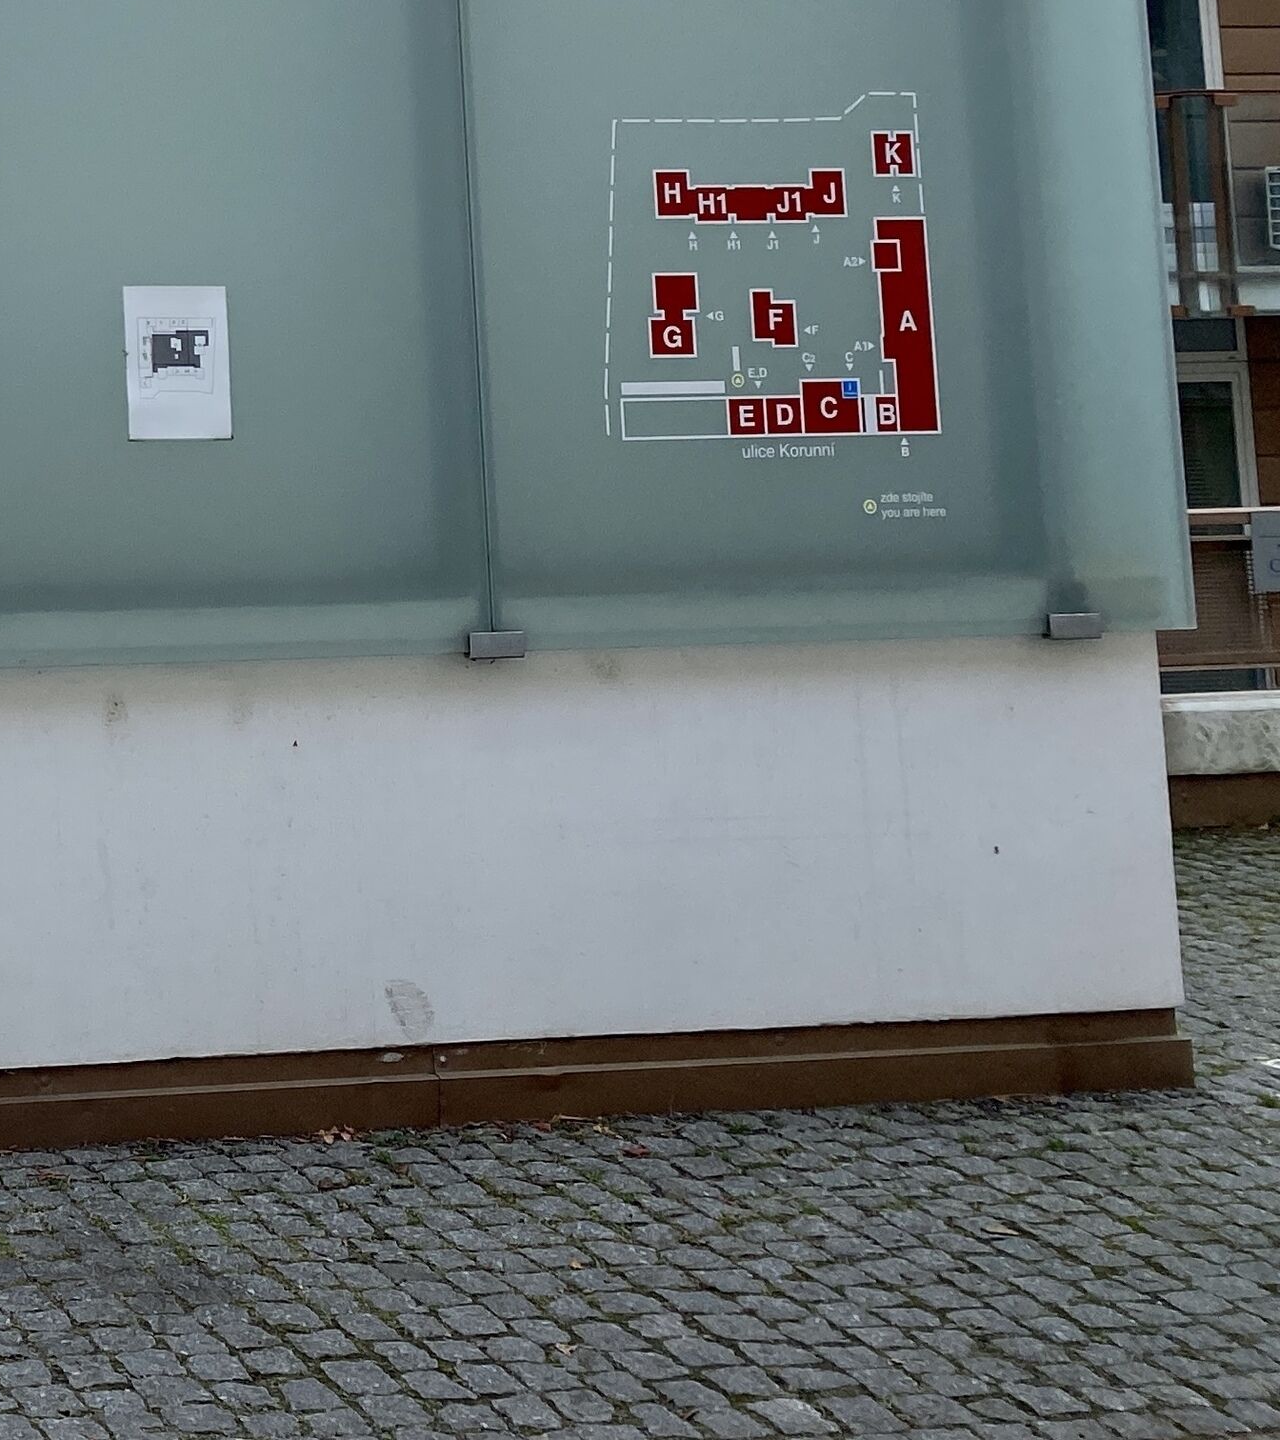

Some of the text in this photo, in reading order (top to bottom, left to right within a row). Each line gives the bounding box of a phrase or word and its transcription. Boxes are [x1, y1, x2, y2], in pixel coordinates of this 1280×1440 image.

[884, 142, 903, 164] K
[664, 182, 681, 204] H
[823, 182, 836, 204] J
[892, 192, 902, 203] K
[698, 193, 727, 214] H1
[776, 191, 801, 213] J1
[689, 240, 698, 251] H
[727, 240, 741, 250] H1
[767, 240, 779, 250] J1
[813, 234, 820, 244] J
[843, 256, 858, 267] A2
[715, 311, 725, 322] G
[768, 309, 783, 331] F
[899, 310, 918, 332] A
[663, 325, 682, 348] G
[811, 325, 819, 335] F
[854, 340, 868, 352] A1
[845, 351, 854, 362] C
[776, 403, 794, 426] D
[820, 396, 839, 419] C
[878, 403, 896, 425] B
[738, 405, 756, 428] E
[741, 442, 836, 459] ulice Korunní
[901, 446, 910, 457] B
[880, 493, 900, 503] zde
[880, 506, 947, 521] you are here
